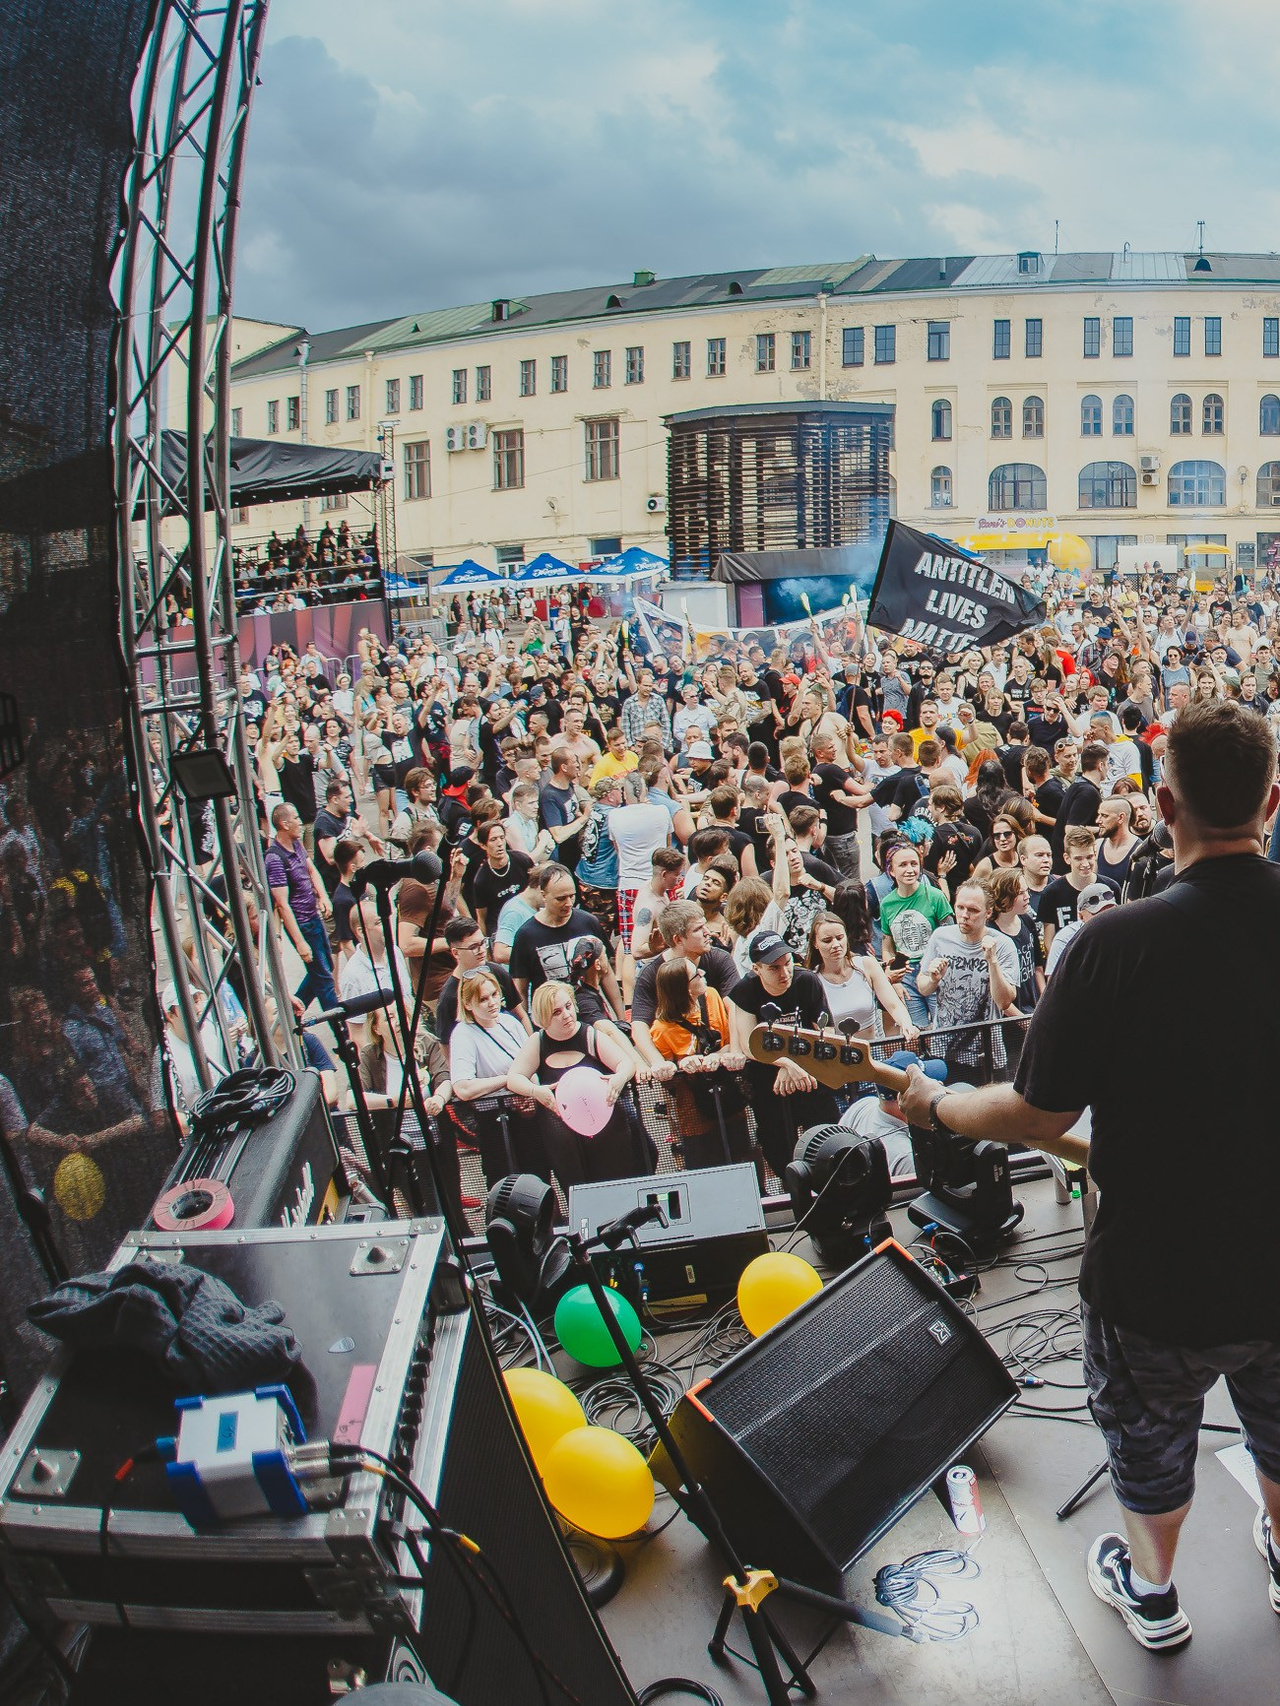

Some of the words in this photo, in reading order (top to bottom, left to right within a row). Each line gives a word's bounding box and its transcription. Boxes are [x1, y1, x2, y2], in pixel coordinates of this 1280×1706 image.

[1007, 517, 1055, 528] DONUTS
[925, 589, 988, 629] LIVES
[898, 618, 981, 653] MATTE
